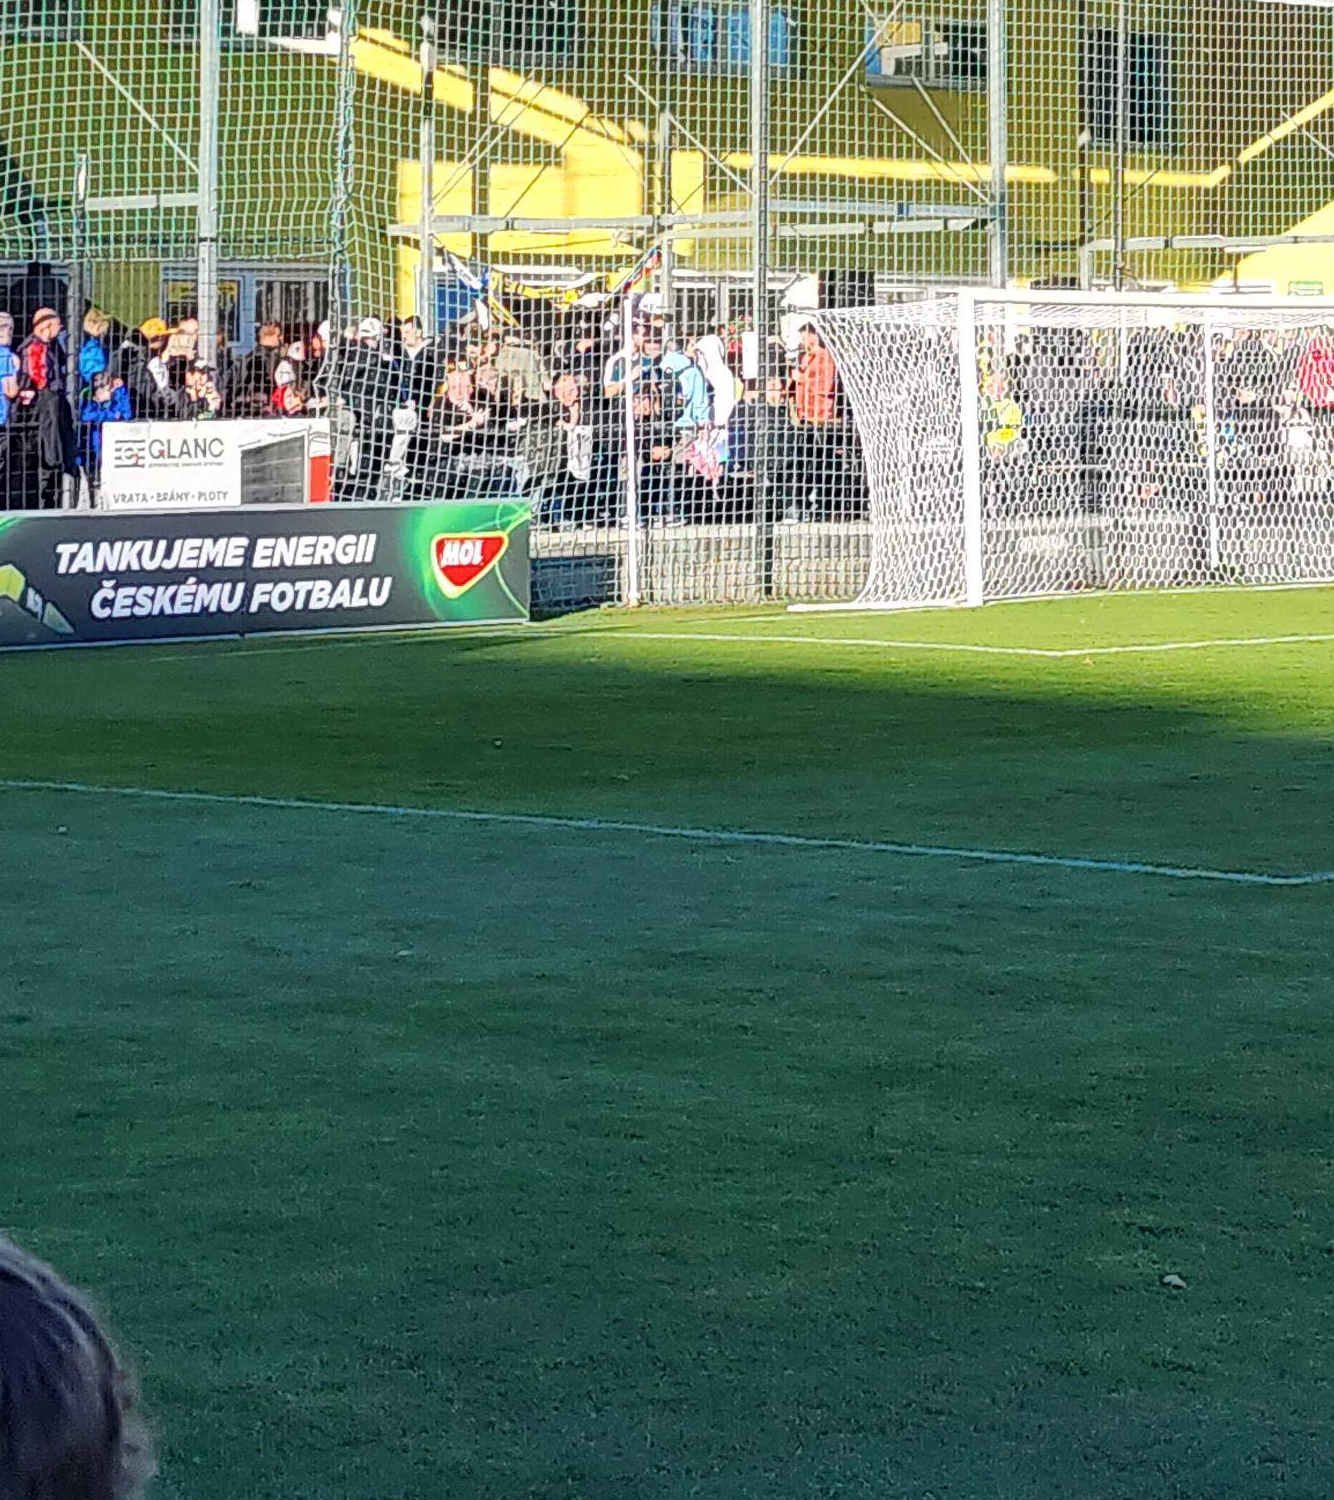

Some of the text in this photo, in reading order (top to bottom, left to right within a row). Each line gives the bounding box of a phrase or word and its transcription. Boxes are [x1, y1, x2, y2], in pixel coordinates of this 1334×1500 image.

[148, 437, 226, 460] GLANC
[113, 492, 149, 505] VRATA
[197, 490, 229, 502] PLOTY
[55, 533, 378, 575] TANKUJEME ENERGII
[440, 539, 485, 568] MOL
[90, 576, 244, 619] ČESKÉMU
[251, 576, 393, 613] FOTBALU
